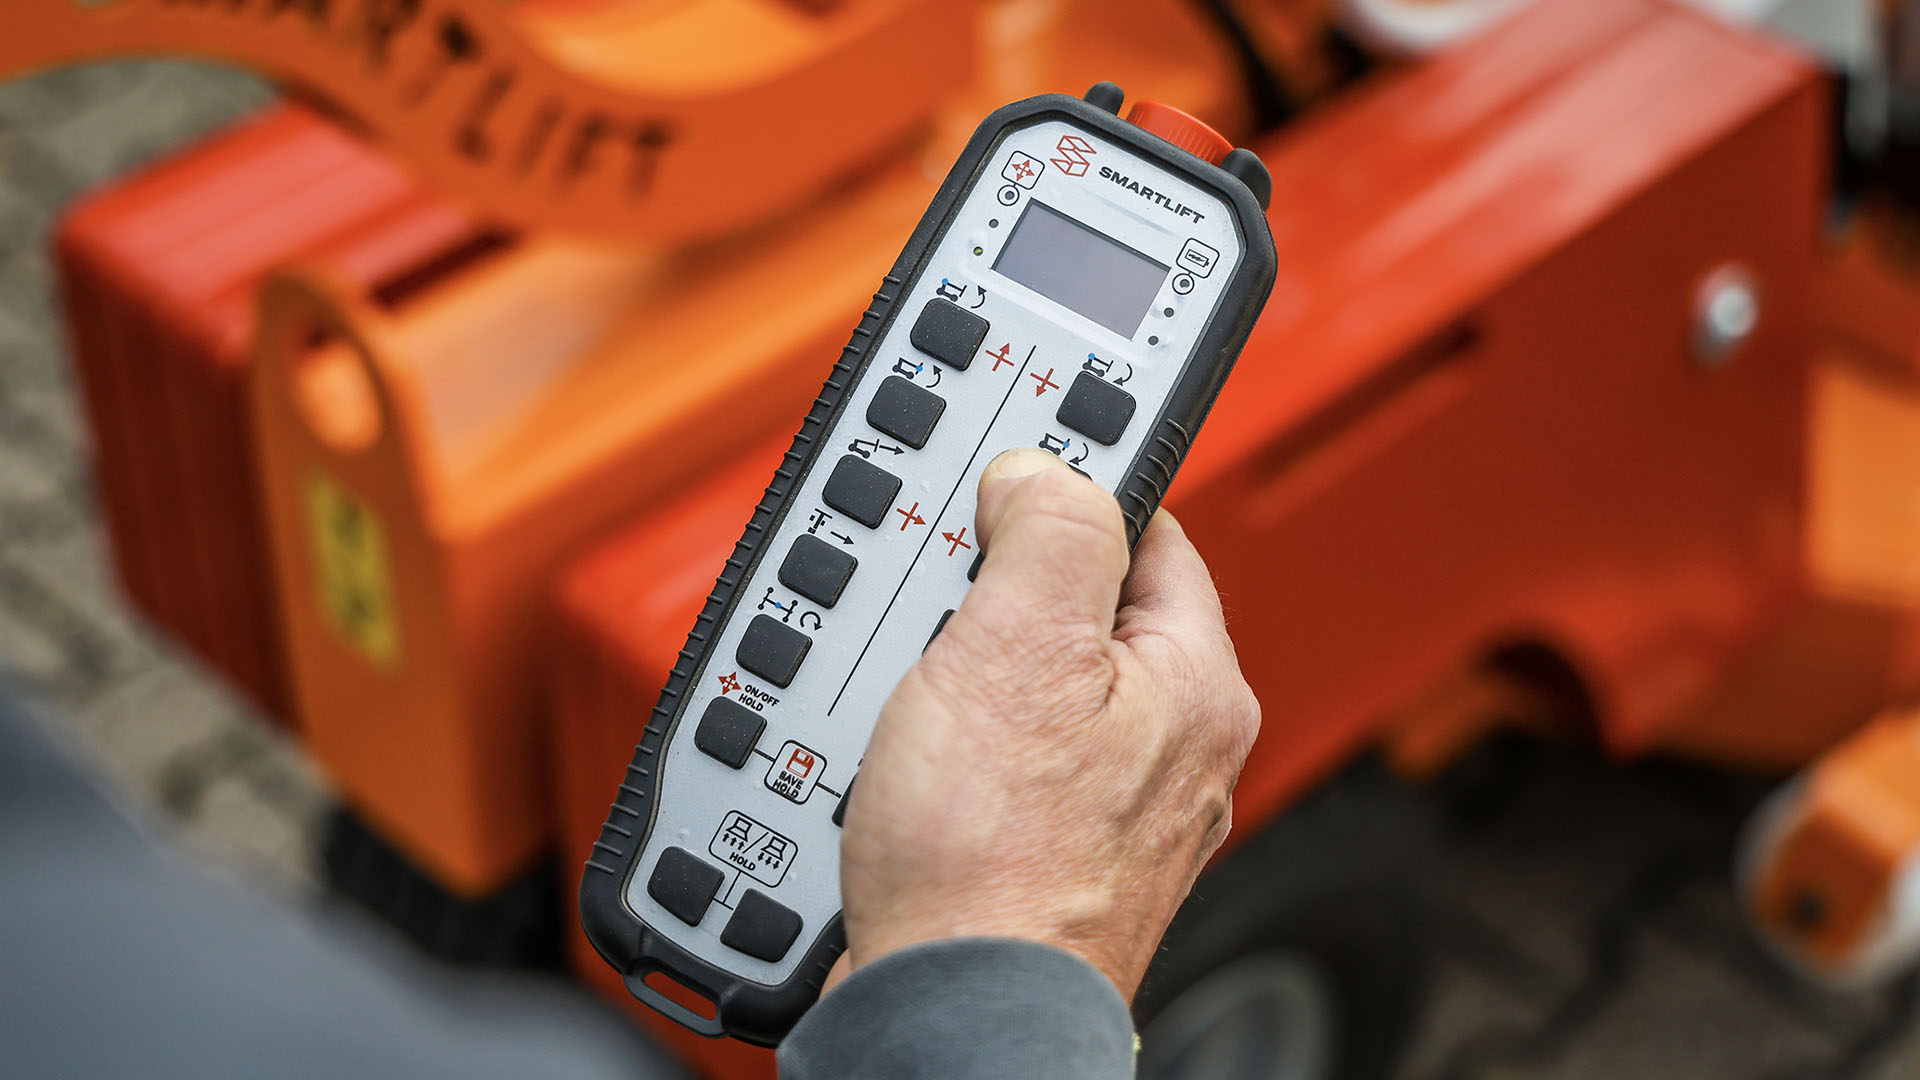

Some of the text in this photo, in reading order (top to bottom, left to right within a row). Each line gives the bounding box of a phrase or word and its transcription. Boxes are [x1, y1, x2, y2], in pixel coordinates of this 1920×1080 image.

[1098, 165, 1206, 225] SMARTLIFT
[738, 693, 764, 712] HOLD
[744, 684, 780, 708] ON/OFF
[772, 779, 800, 798] HOLD
[779, 770, 804, 790] SAVE
[729, 851, 757, 872] HOLD
